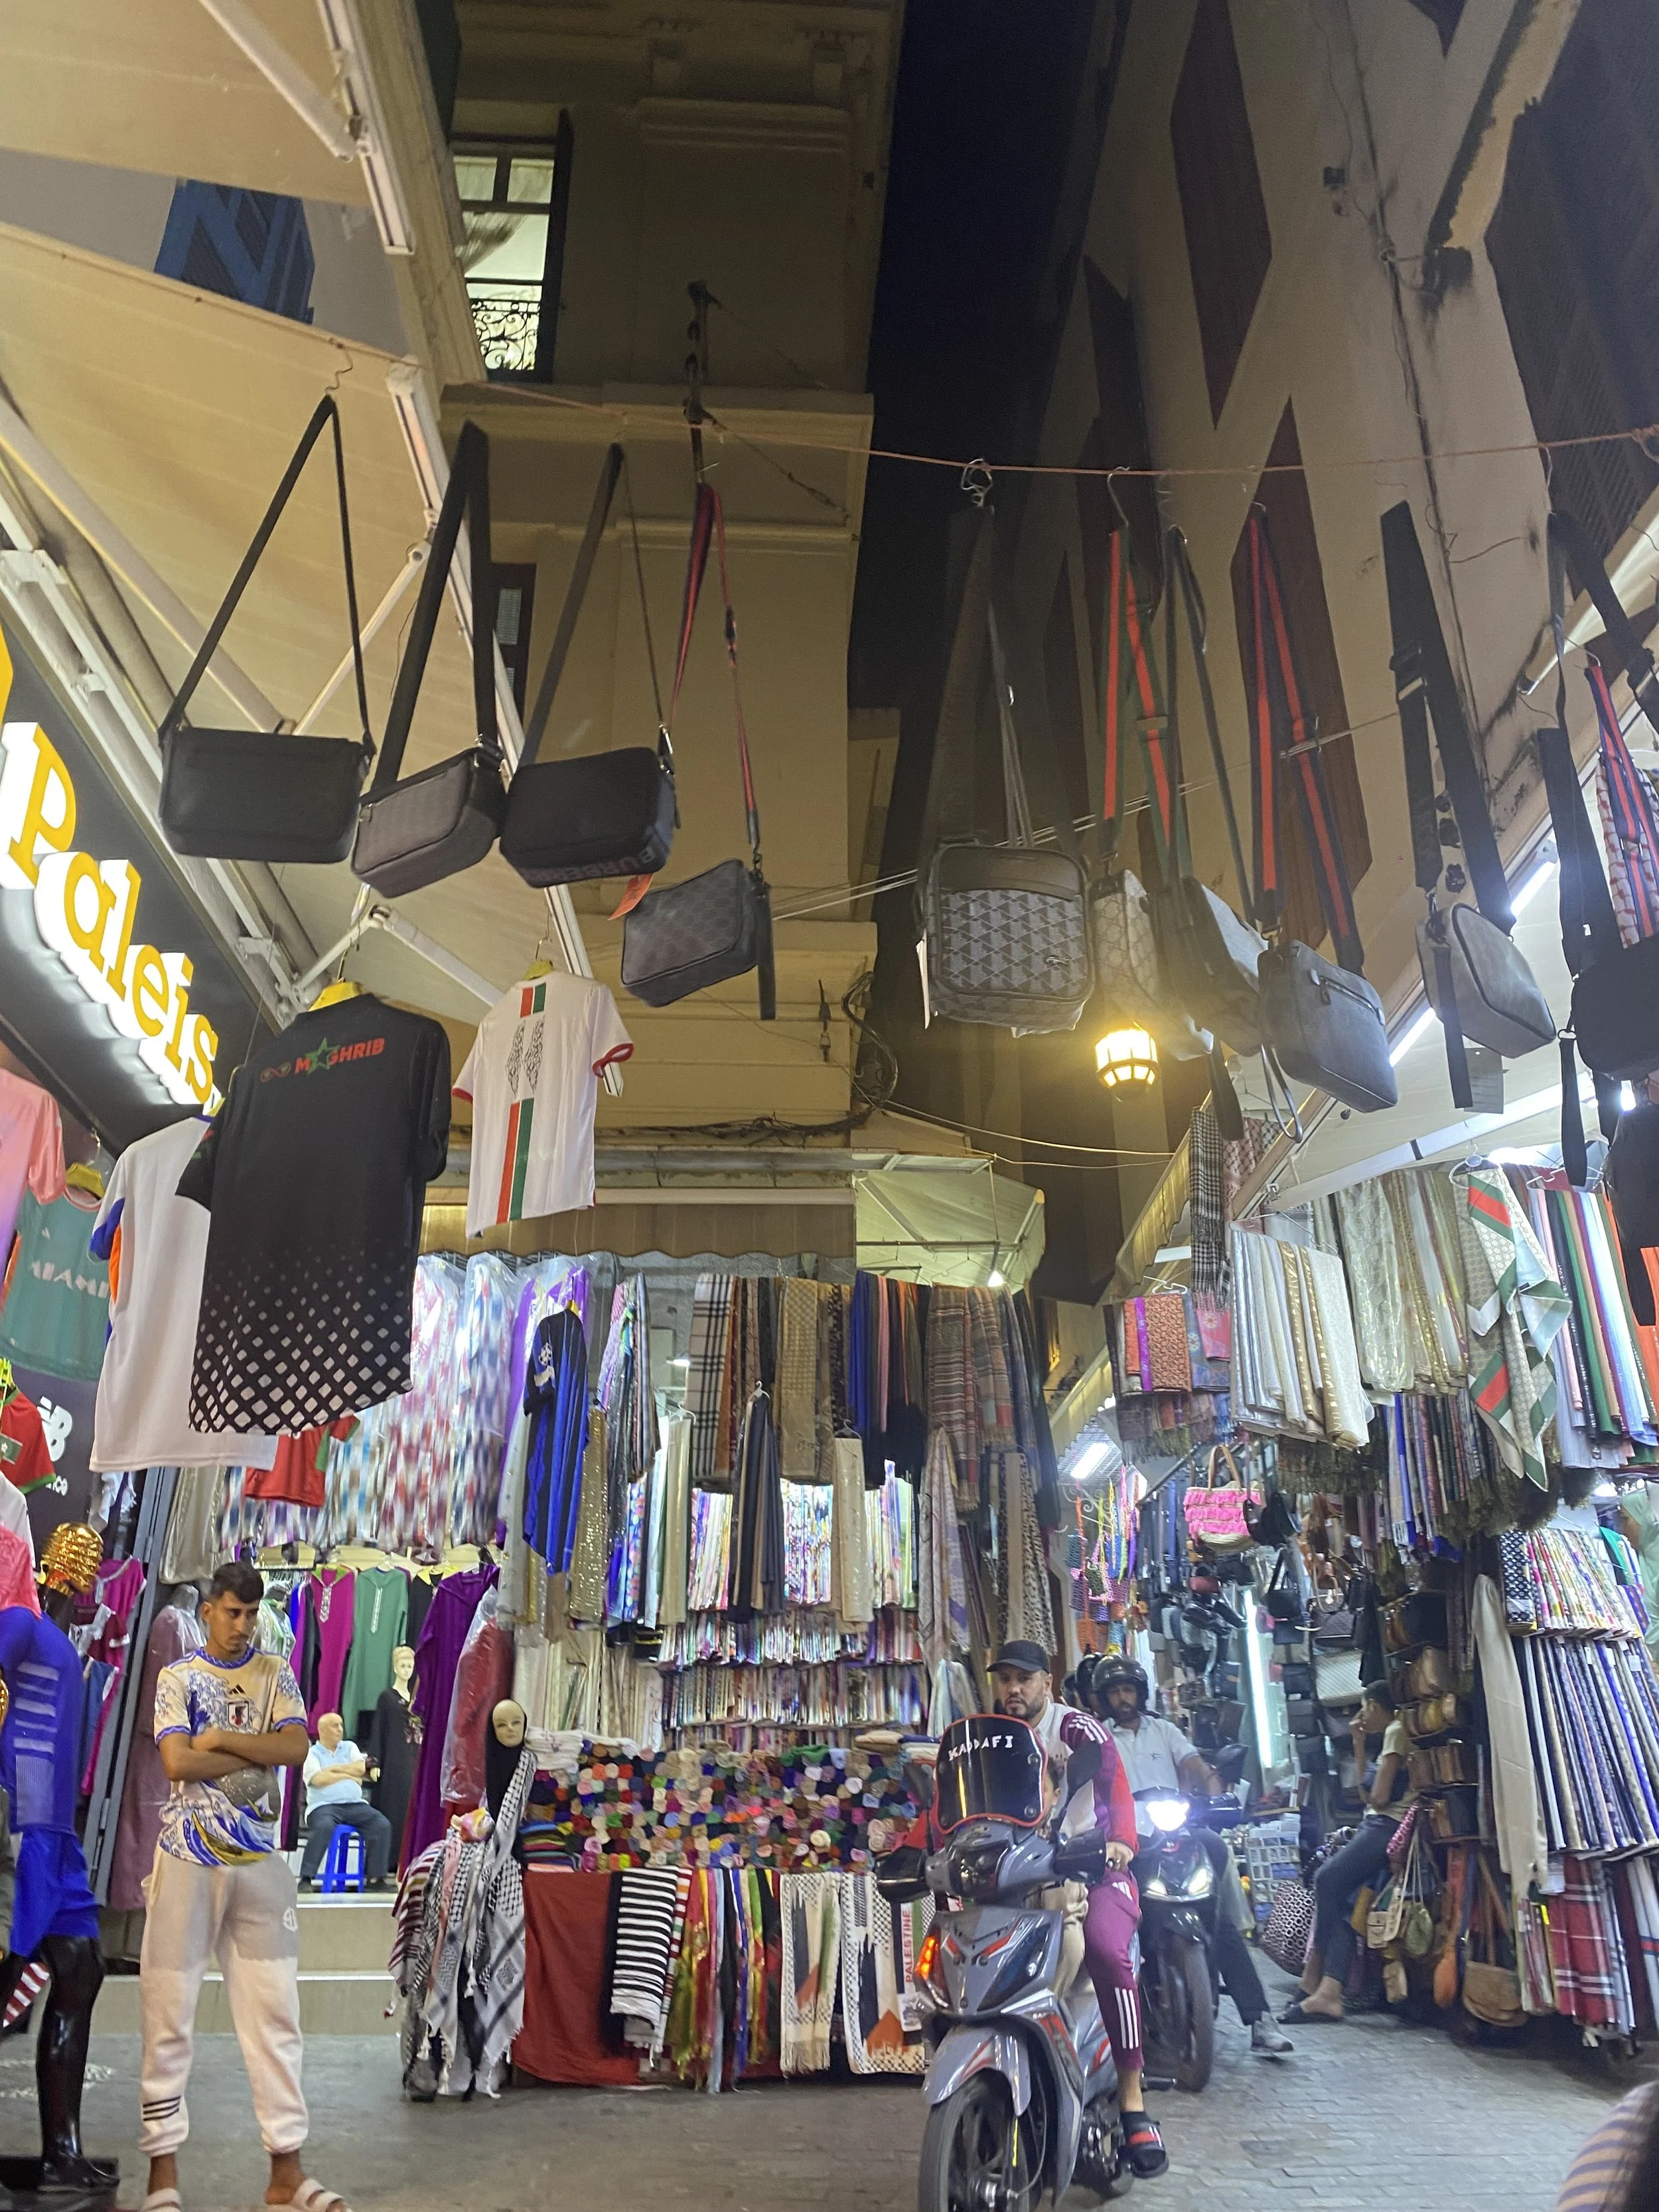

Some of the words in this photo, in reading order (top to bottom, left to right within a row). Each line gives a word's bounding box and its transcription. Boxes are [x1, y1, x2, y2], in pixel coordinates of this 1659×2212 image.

[521, 845, 657, 883] BURBER
[5, 722, 219, 1104] Paleis
[948, 1734, 1014, 1762] KADDAFI
[902, 1909, 914, 1983] PALESTINE
